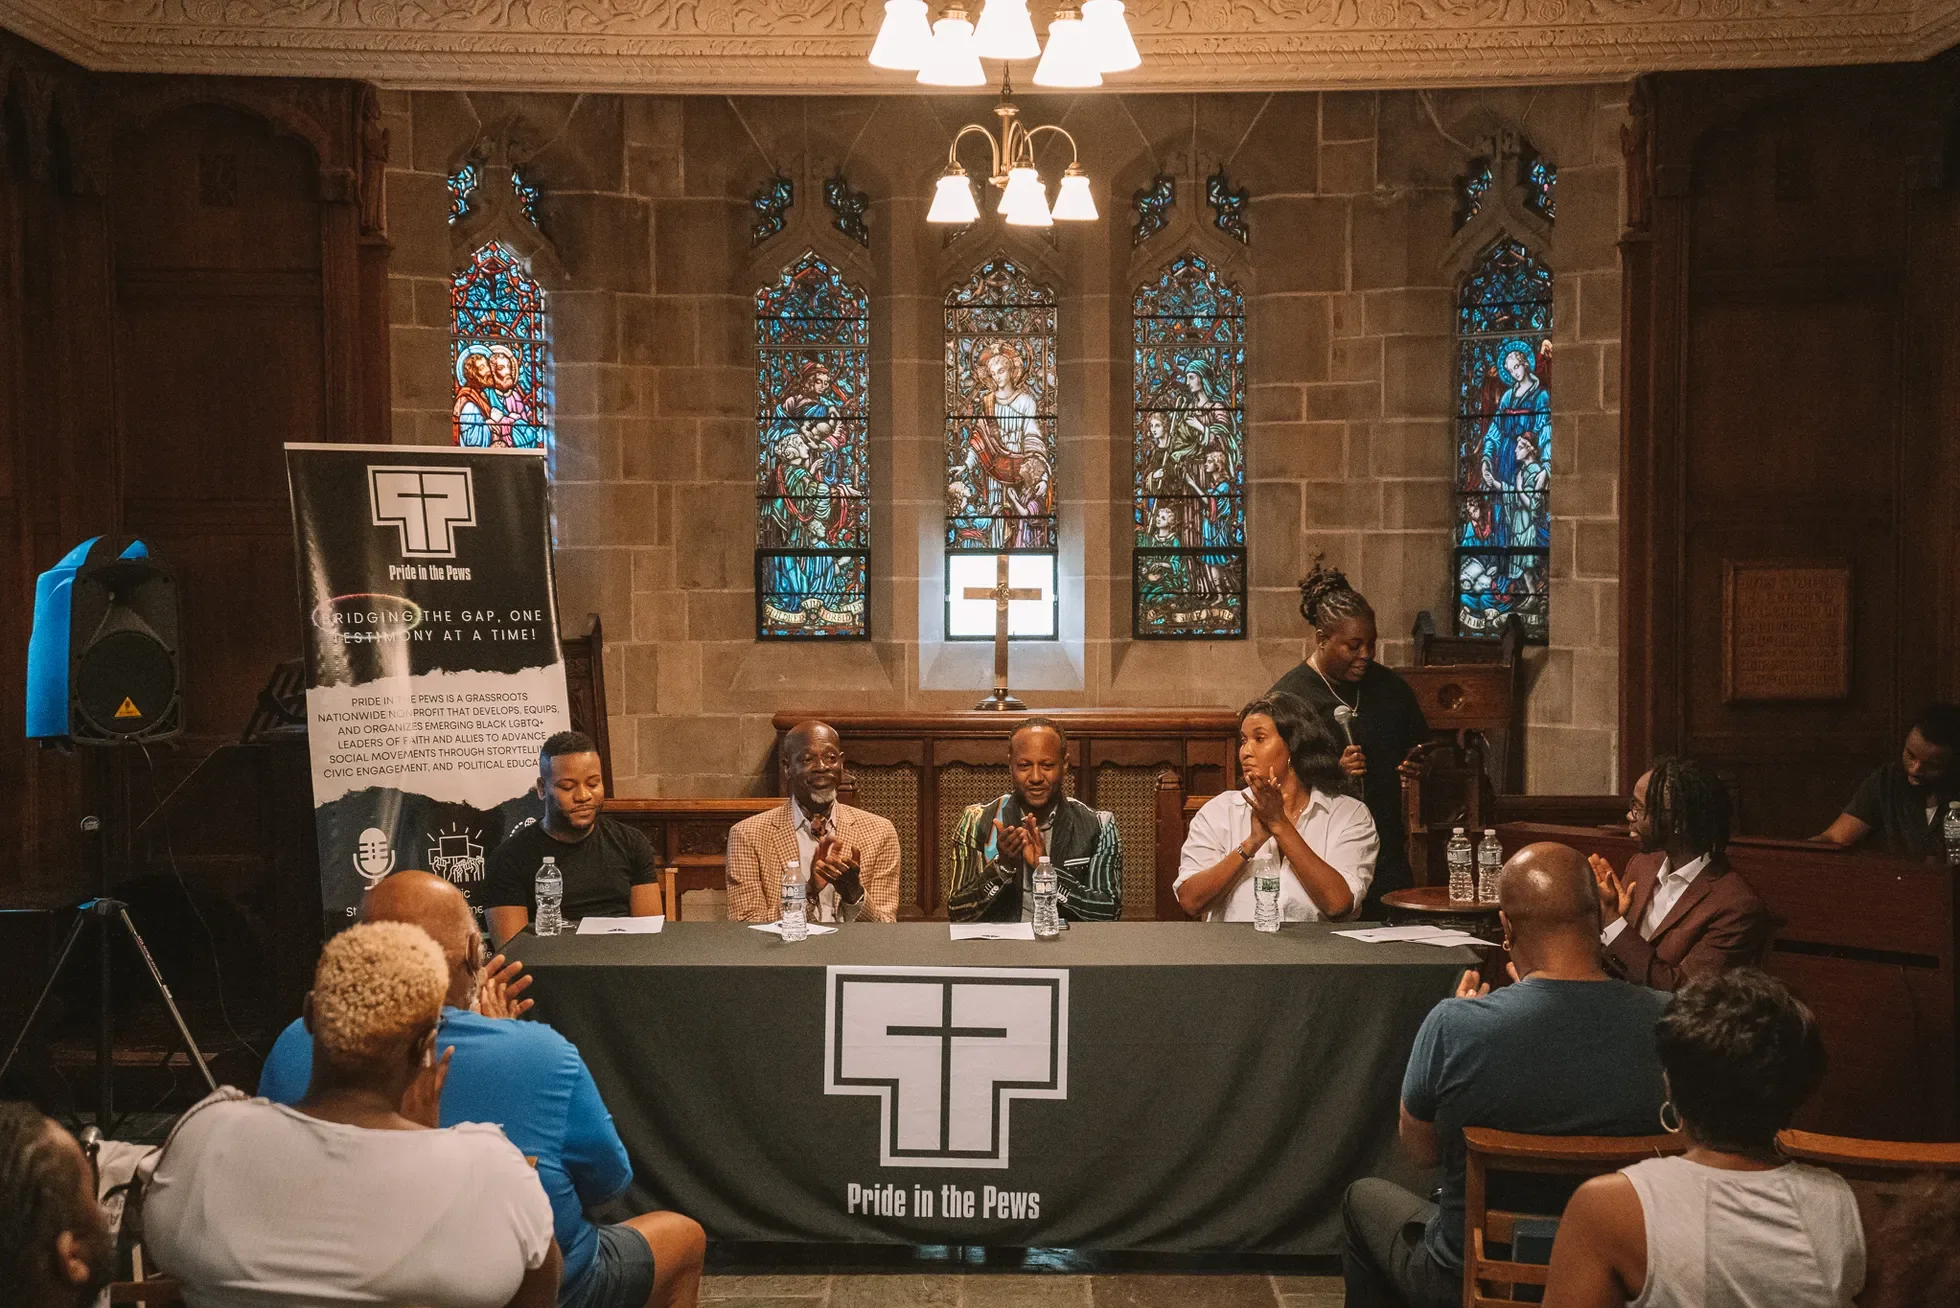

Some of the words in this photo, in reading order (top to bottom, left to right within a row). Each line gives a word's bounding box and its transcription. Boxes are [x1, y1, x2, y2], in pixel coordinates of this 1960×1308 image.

[389, 565, 417, 580] Pride
[418, 565, 427, 580] in
[429, 565, 444, 580] the
[446, 565, 471, 580] Pews
[423, 611, 451, 621] THE
[462, 610, 501, 623] GAP,
[510, 610, 542, 621] ONE
[444, 630, 462, 641] AT
[473, 630, 481, 641] A
[492, 629, 536, 640] TIME!
[352, 697, 380, 706] PRIDE
[384, 696, 394, 705] IN
[419, 694, 444, 704] PEWS
[446, 694, 454, 702] IS
[457, 694, 463, 702] A
[466, 693, 528, 702] GRASSROOTS
[318, 711, 386, 722] NATIONWIDE
[447, 707, 470, 716] THAT
[524, 705, 559, 714] EQUIPS,
[338, 726, 361, 735] AND
[364, 722, 423, 733] ORGANIZES
[424, 720, 474, 730] EMERGING
[476, 720, 506, 728] BLACK
[509, 719, 544, 728] LGBTQ+
[338, 739, 383, 749] LEADERS
[386, 737, 400, 746] OF
[433, 735, 452, 743] AND
[455, 734, 484, 743] ALLIES
[486, 733, 499, 741] TO
[502, 732, 546, 741] ADVANCE
[330, 754, 369, 764] SOCIAL
[372, 749, 436, 761] MOVEMENTS
[439, 748, 484, 757] THROUGH
[324, 768, 354, 778] CIVIC
[357, 763, 430, 776] ENGAGEMENT,
[433, 762, 453, 771] AND
[458, 760, 504, 770] POLITICAL
[847, 1183, 906, 1216] Pride
[914, 1184, 934, 1217] in
[941, 1184, 975, 1218] the
[983, 1185, 1040, 1219] Pews
